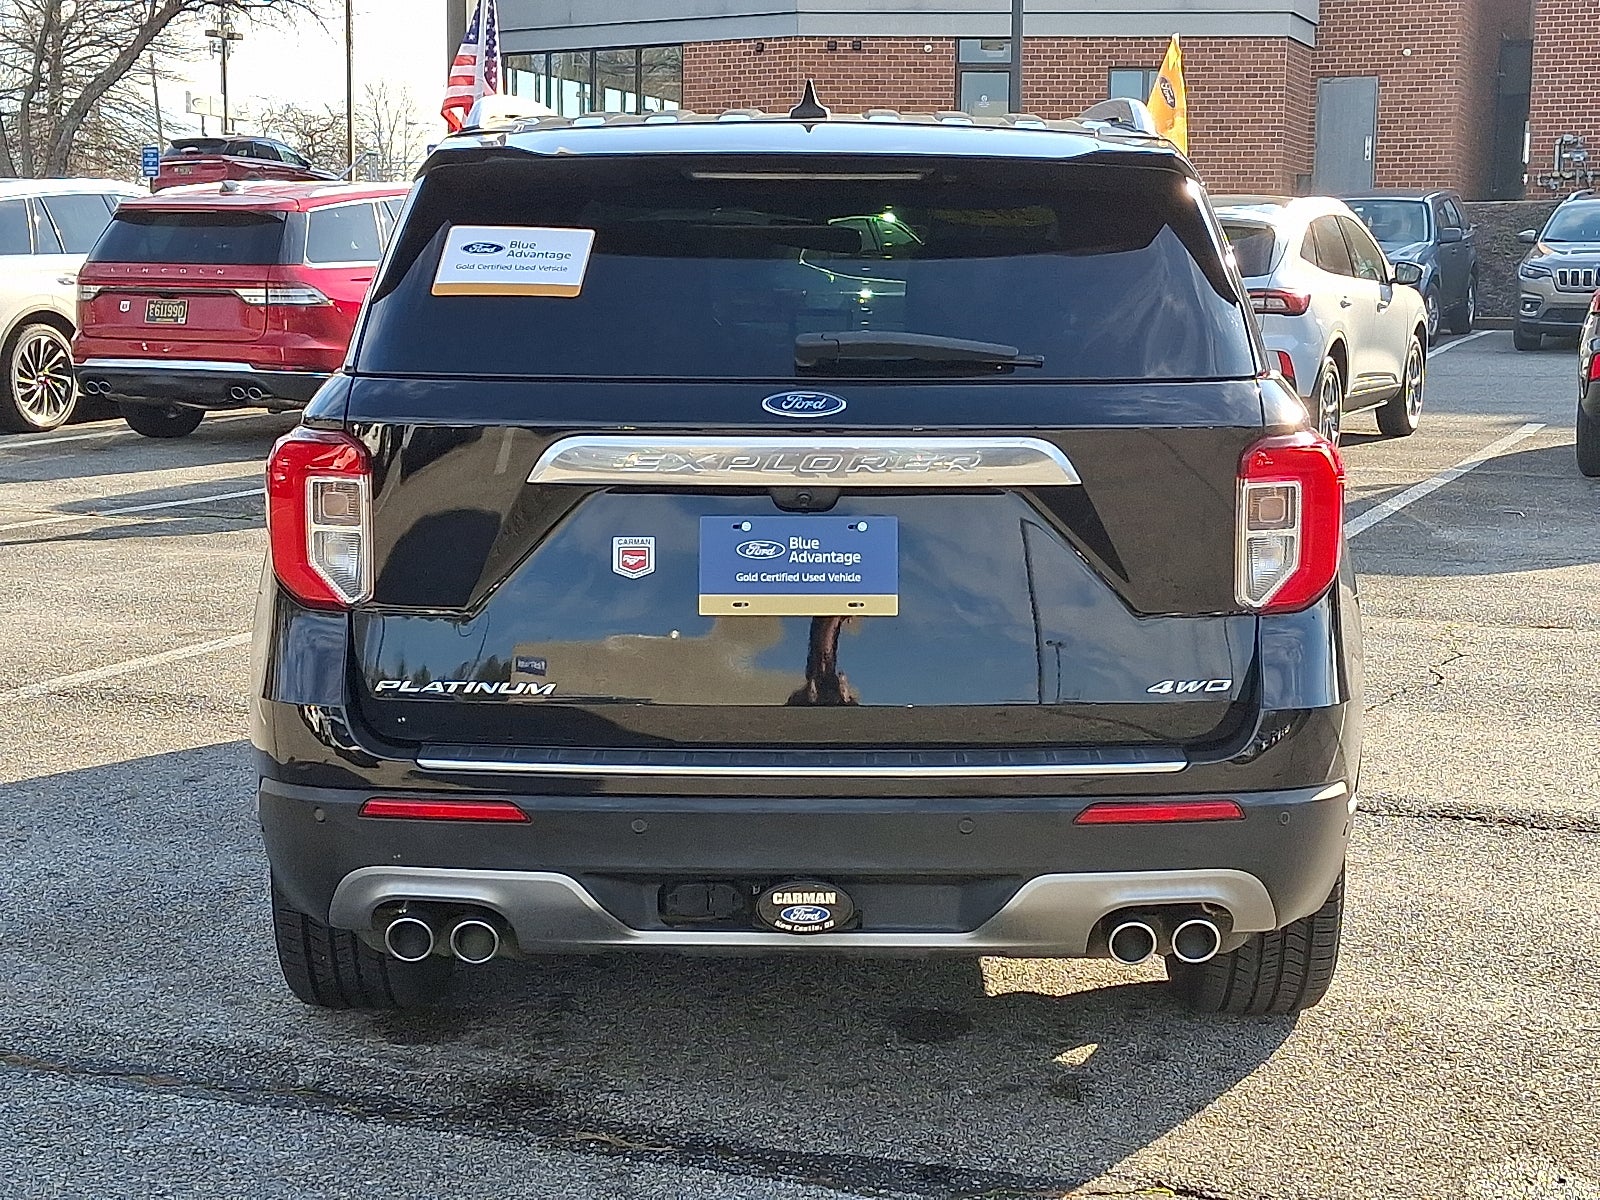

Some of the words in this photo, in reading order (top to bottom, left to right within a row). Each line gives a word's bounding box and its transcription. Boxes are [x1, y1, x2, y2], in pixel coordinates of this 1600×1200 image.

[509, 240, 537, 250] Blue
[506, 250, 572, 260] Advantage
[110, 267, 224, 275] LINCOLN
[781, 394, 827, 410] Ford
[617, 451, 983, 473] EXPLORER
[789, 536, 820, 549] Blue
[788, 551, 862, 565] Advantage
[735, 572, 758, 582] Gold
[760, 572, 800, 582] Certified
[801, 572, 826, 582] Used
[828, 572, 862, 582] Vehicle
[375, 680, 557, 695] PLATINUM
[1146, 679, 1232, 694] 4WD
[772, 892, 837, 905] CARMAN
[790, 907, 821, 920] Ford
